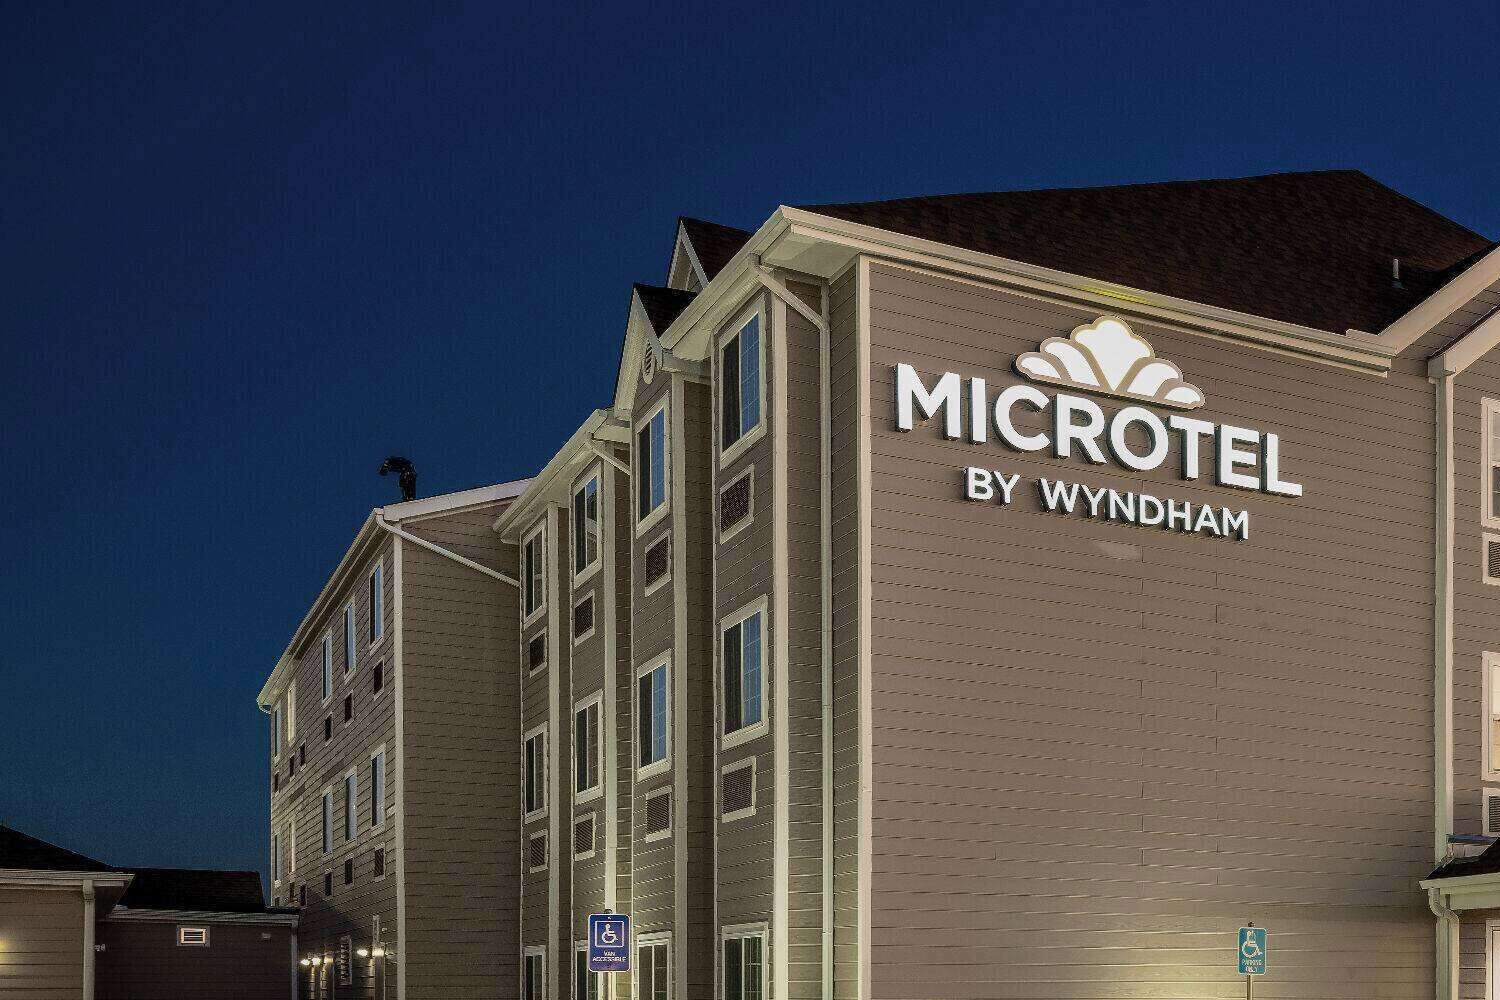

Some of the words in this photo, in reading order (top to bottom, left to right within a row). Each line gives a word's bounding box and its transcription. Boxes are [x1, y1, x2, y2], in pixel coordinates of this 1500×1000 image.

[896, 362, 1303, 498] MICROTEL
[966, 467, 1020, 505] BY
[1038, 478, 1249, 541] WYNDHAM
